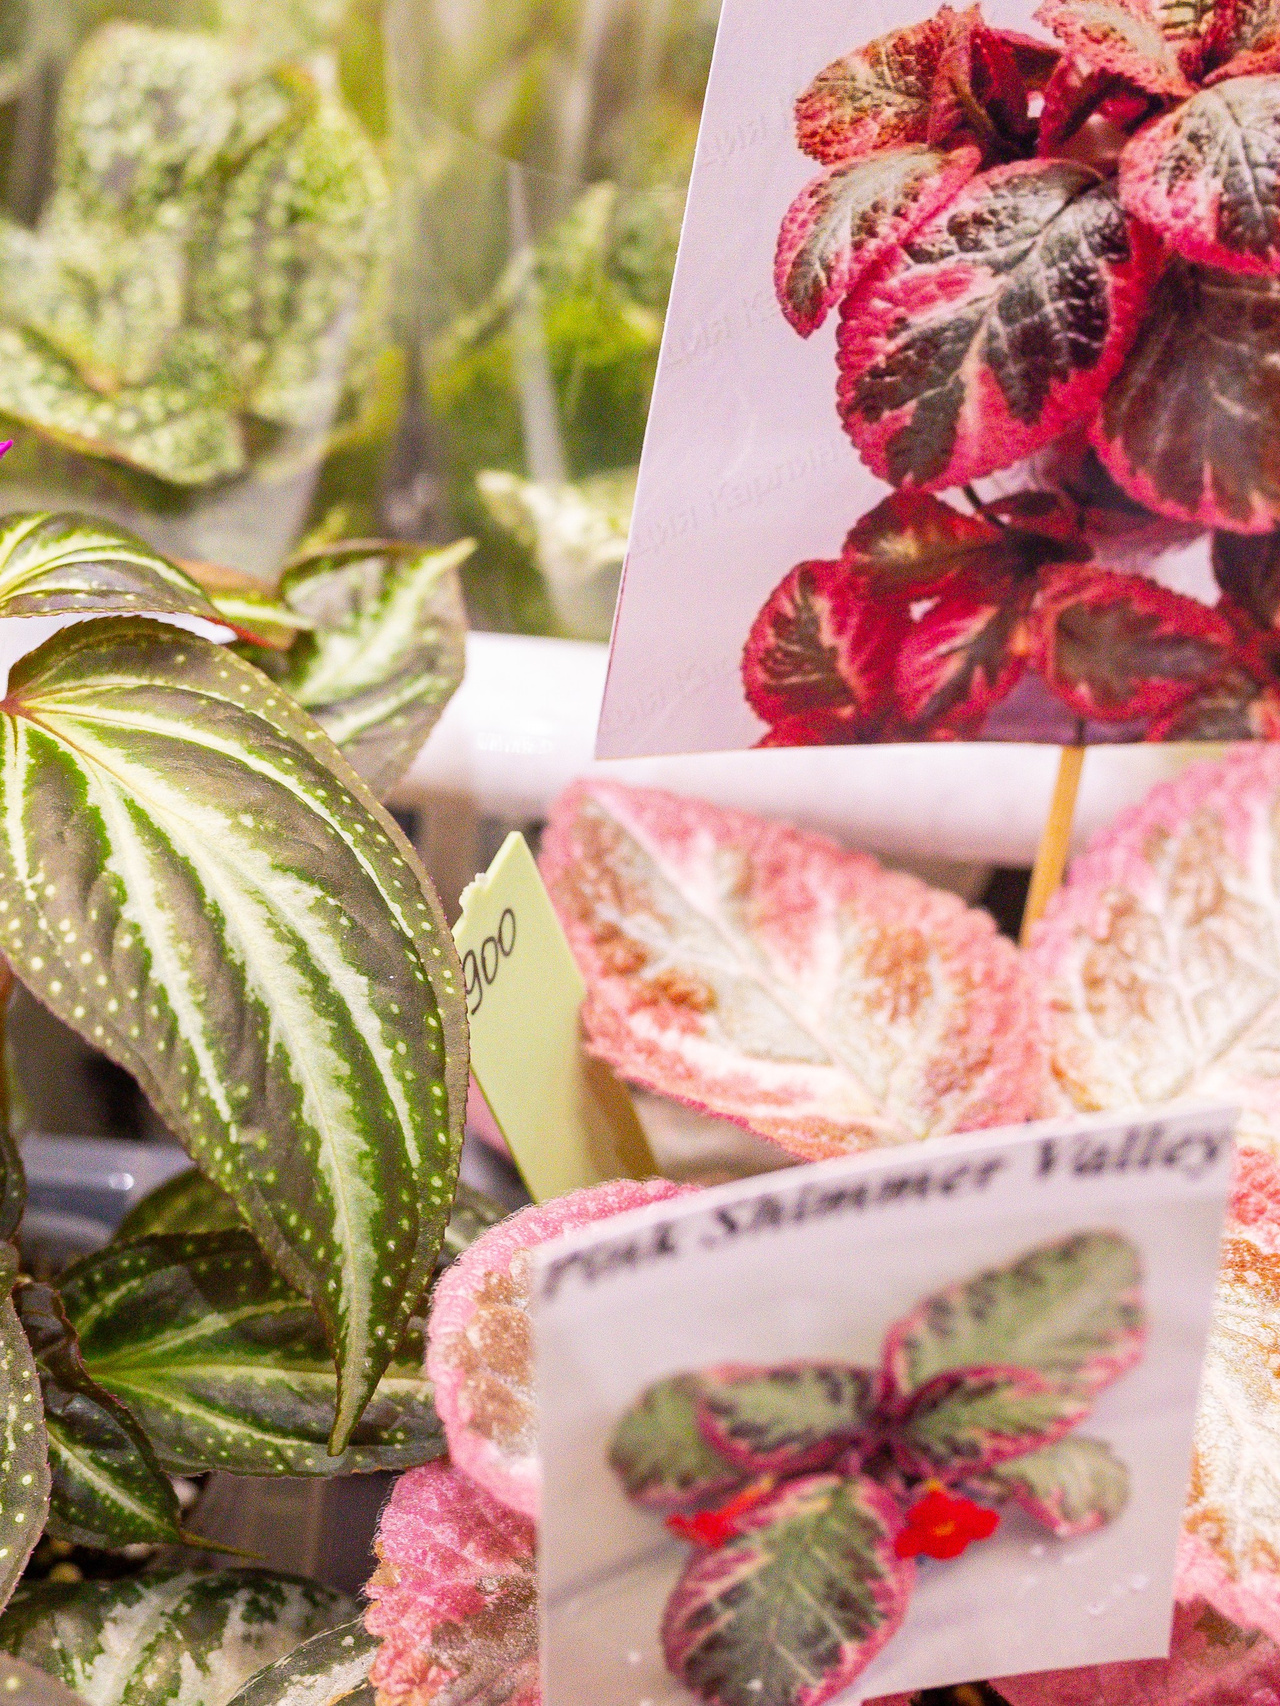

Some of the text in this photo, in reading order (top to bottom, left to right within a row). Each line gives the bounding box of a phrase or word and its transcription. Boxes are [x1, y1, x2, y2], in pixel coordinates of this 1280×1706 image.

[540, 1122, 1230, 1301] Pink Shimmer Valley
